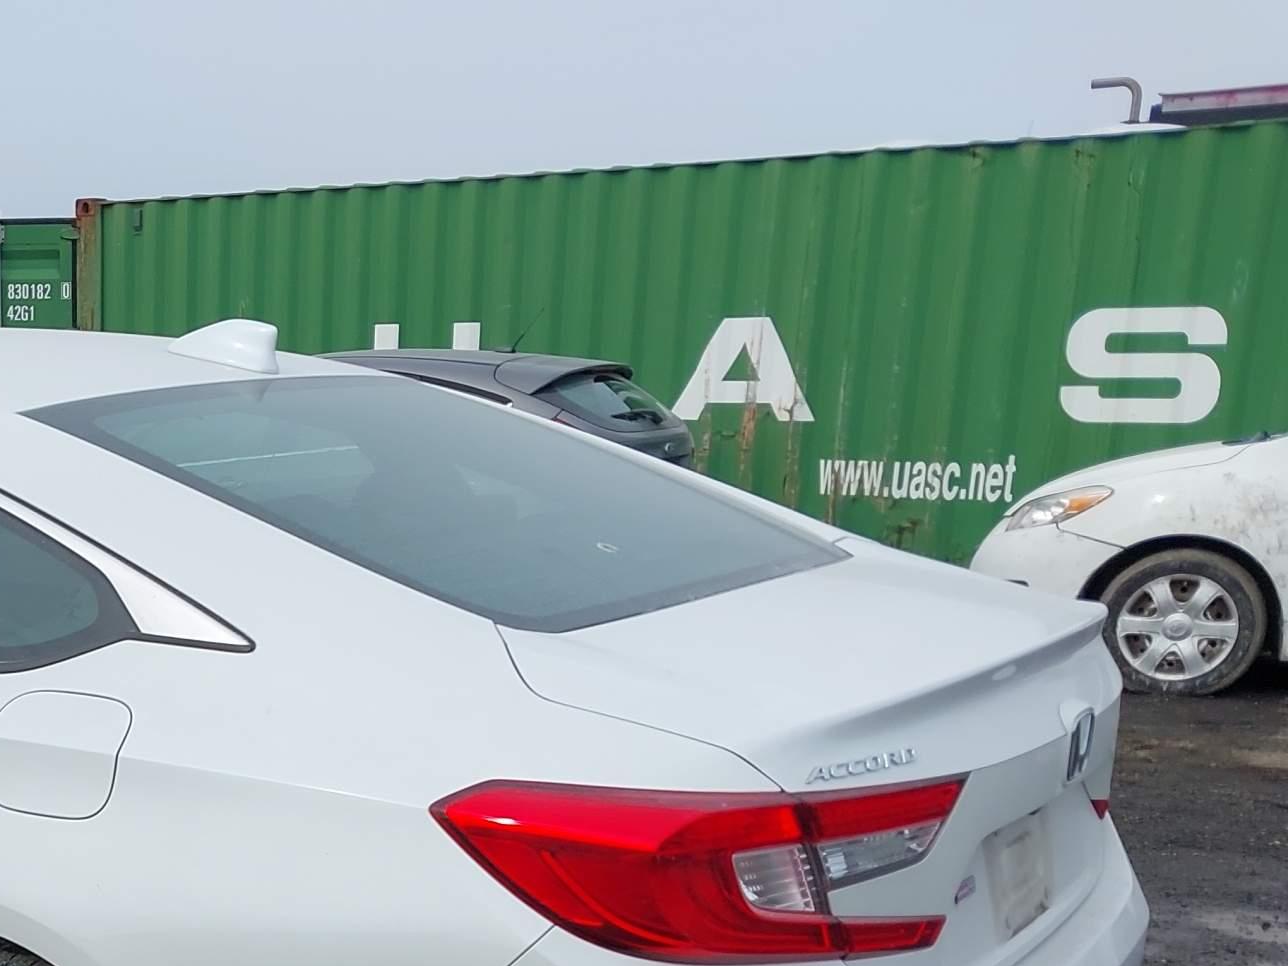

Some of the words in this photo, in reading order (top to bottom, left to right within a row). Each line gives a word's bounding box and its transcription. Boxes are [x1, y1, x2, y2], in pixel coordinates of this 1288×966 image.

[7, 283, 51, 300] 830182
[6, 305, 35, 321] 42G1
[819, 454, 1016, 503] www.uasc.net
[805, 749, 917, 785] ACCORD
